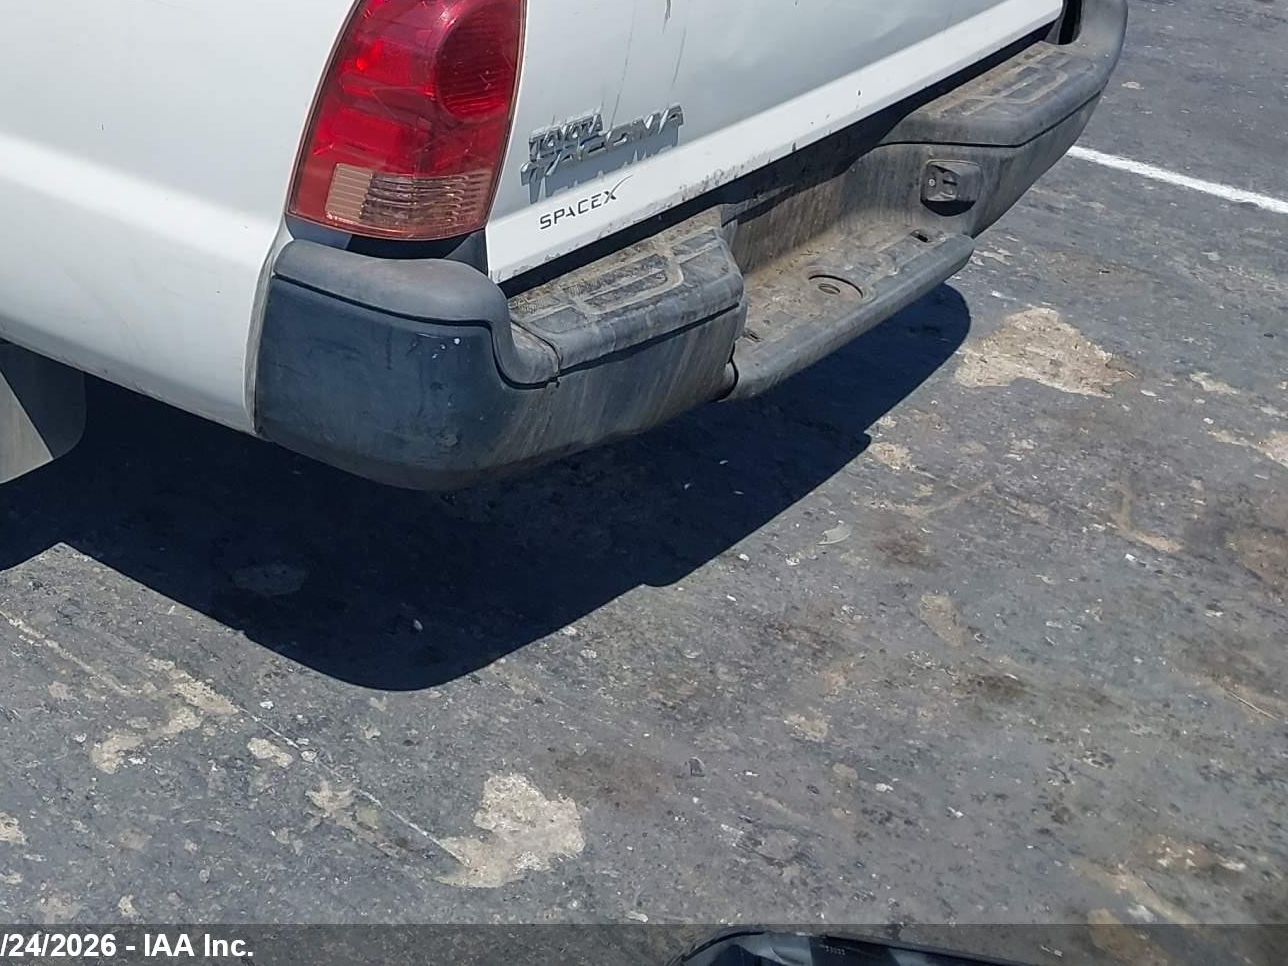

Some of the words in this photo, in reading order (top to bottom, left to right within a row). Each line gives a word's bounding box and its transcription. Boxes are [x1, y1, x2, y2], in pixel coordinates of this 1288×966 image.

[520, 103, 684, 198] TACOMA
[529, 111, 604, 163] TOYOTA
[539, 174, 633, 231] SPACEX
